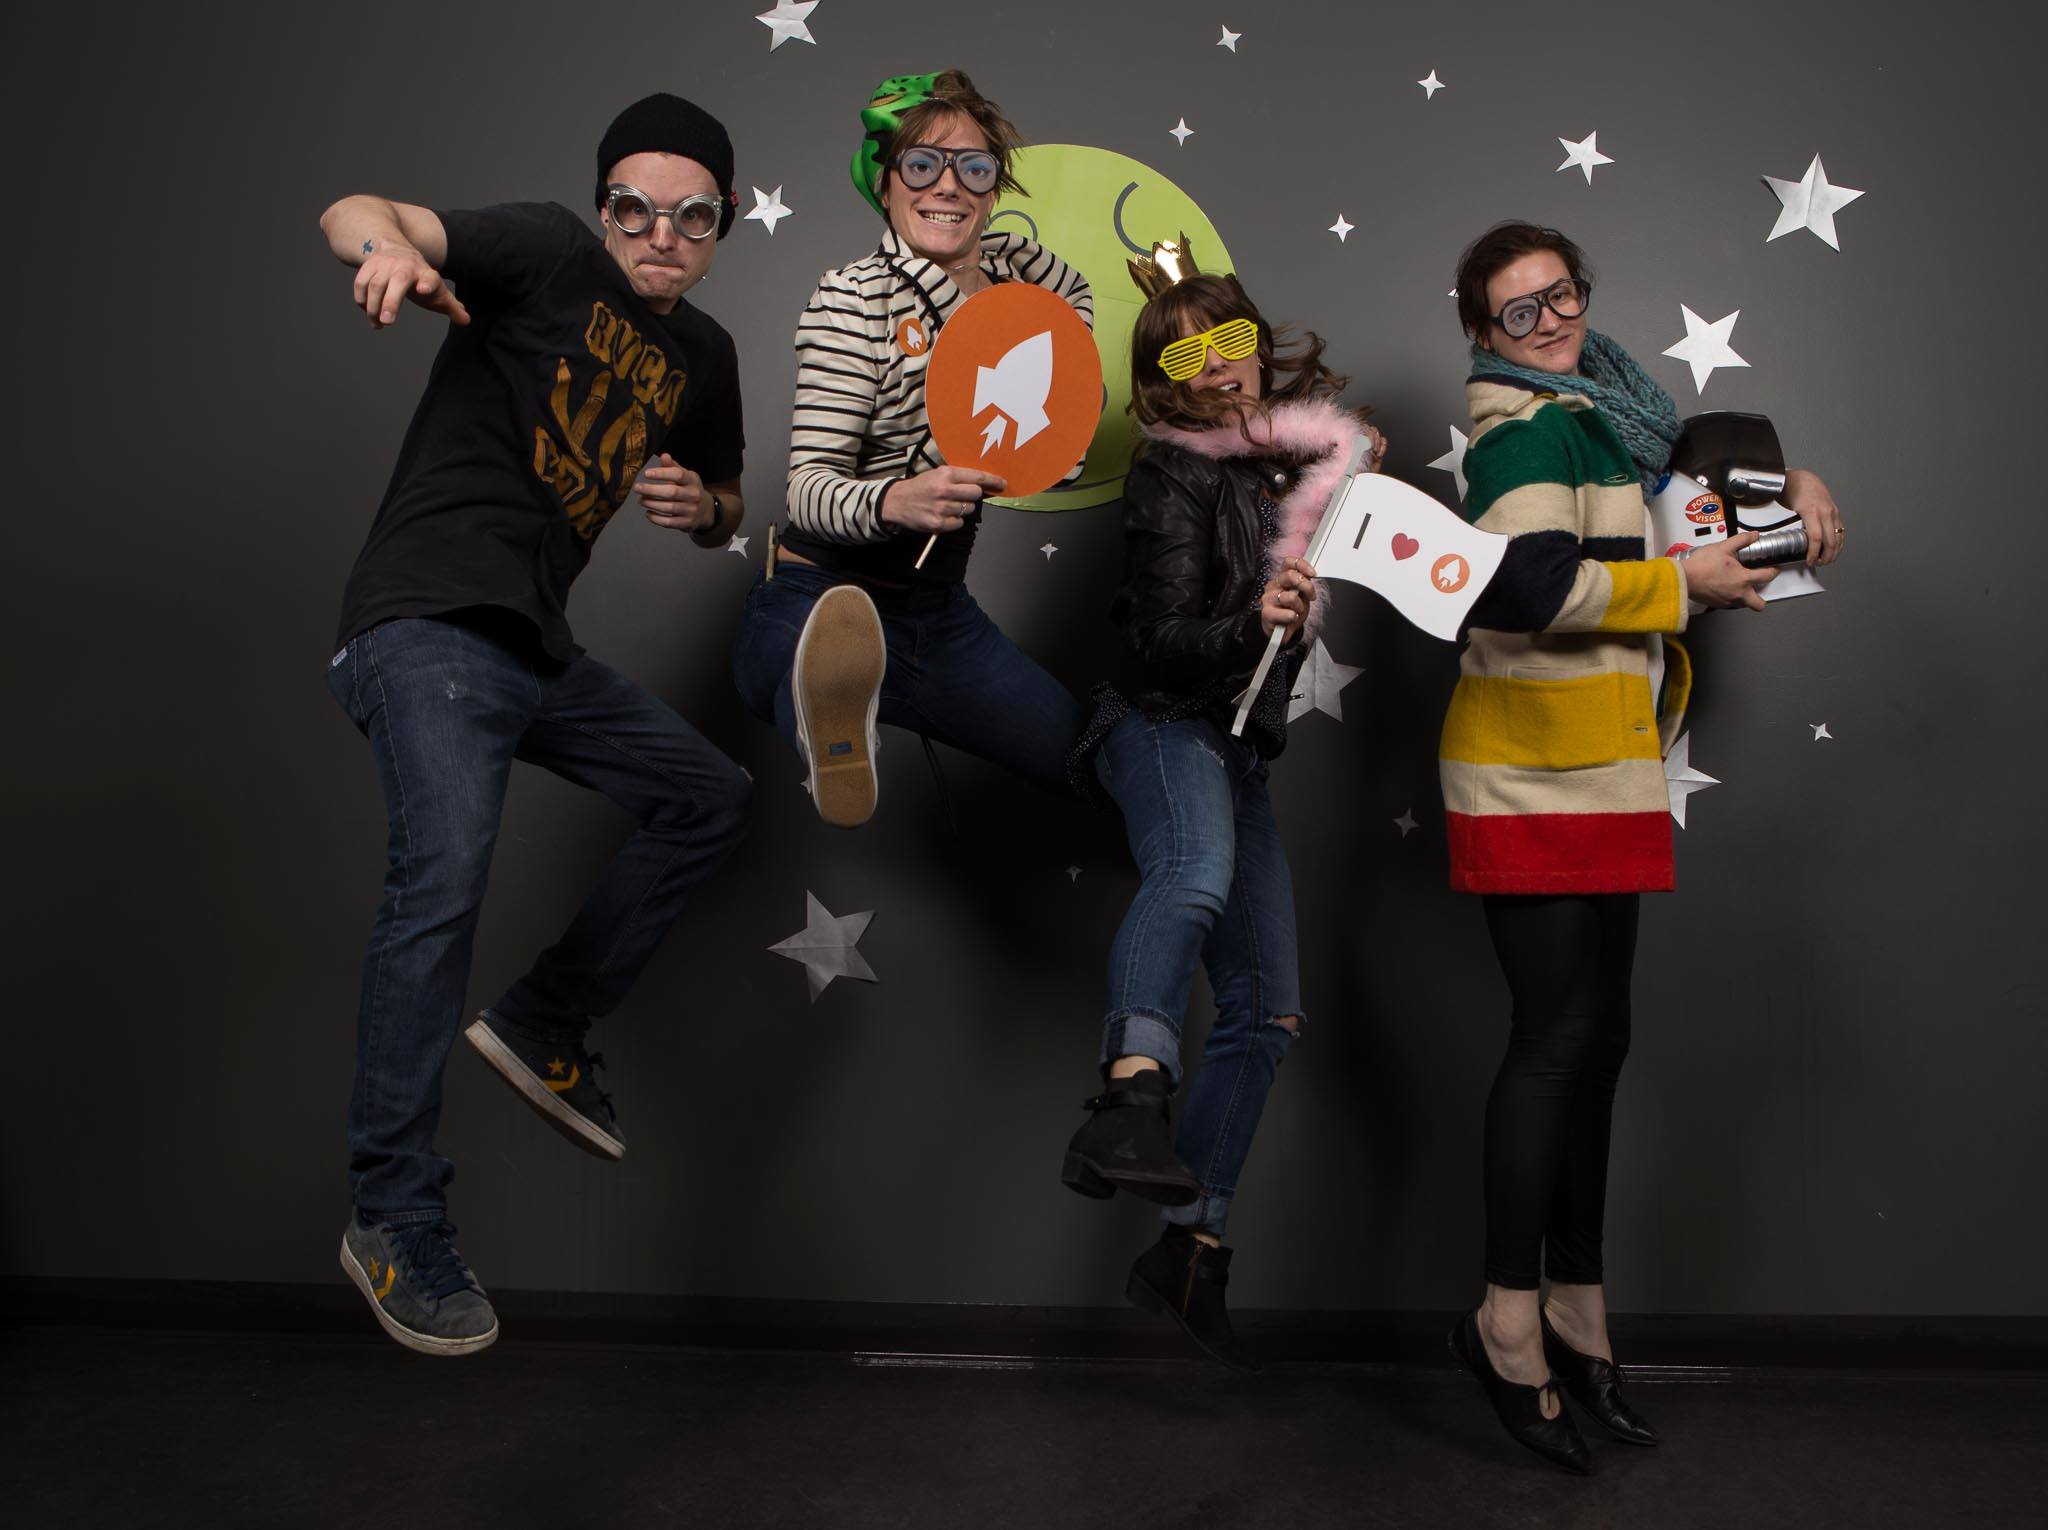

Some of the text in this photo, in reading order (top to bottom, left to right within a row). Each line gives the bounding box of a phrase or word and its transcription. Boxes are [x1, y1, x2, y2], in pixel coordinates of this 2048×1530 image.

[1692, 495, 1719, 509] POWER
[1695, 514, 1722, 522] VISOR
[1353, 513, 1372, 549] I
